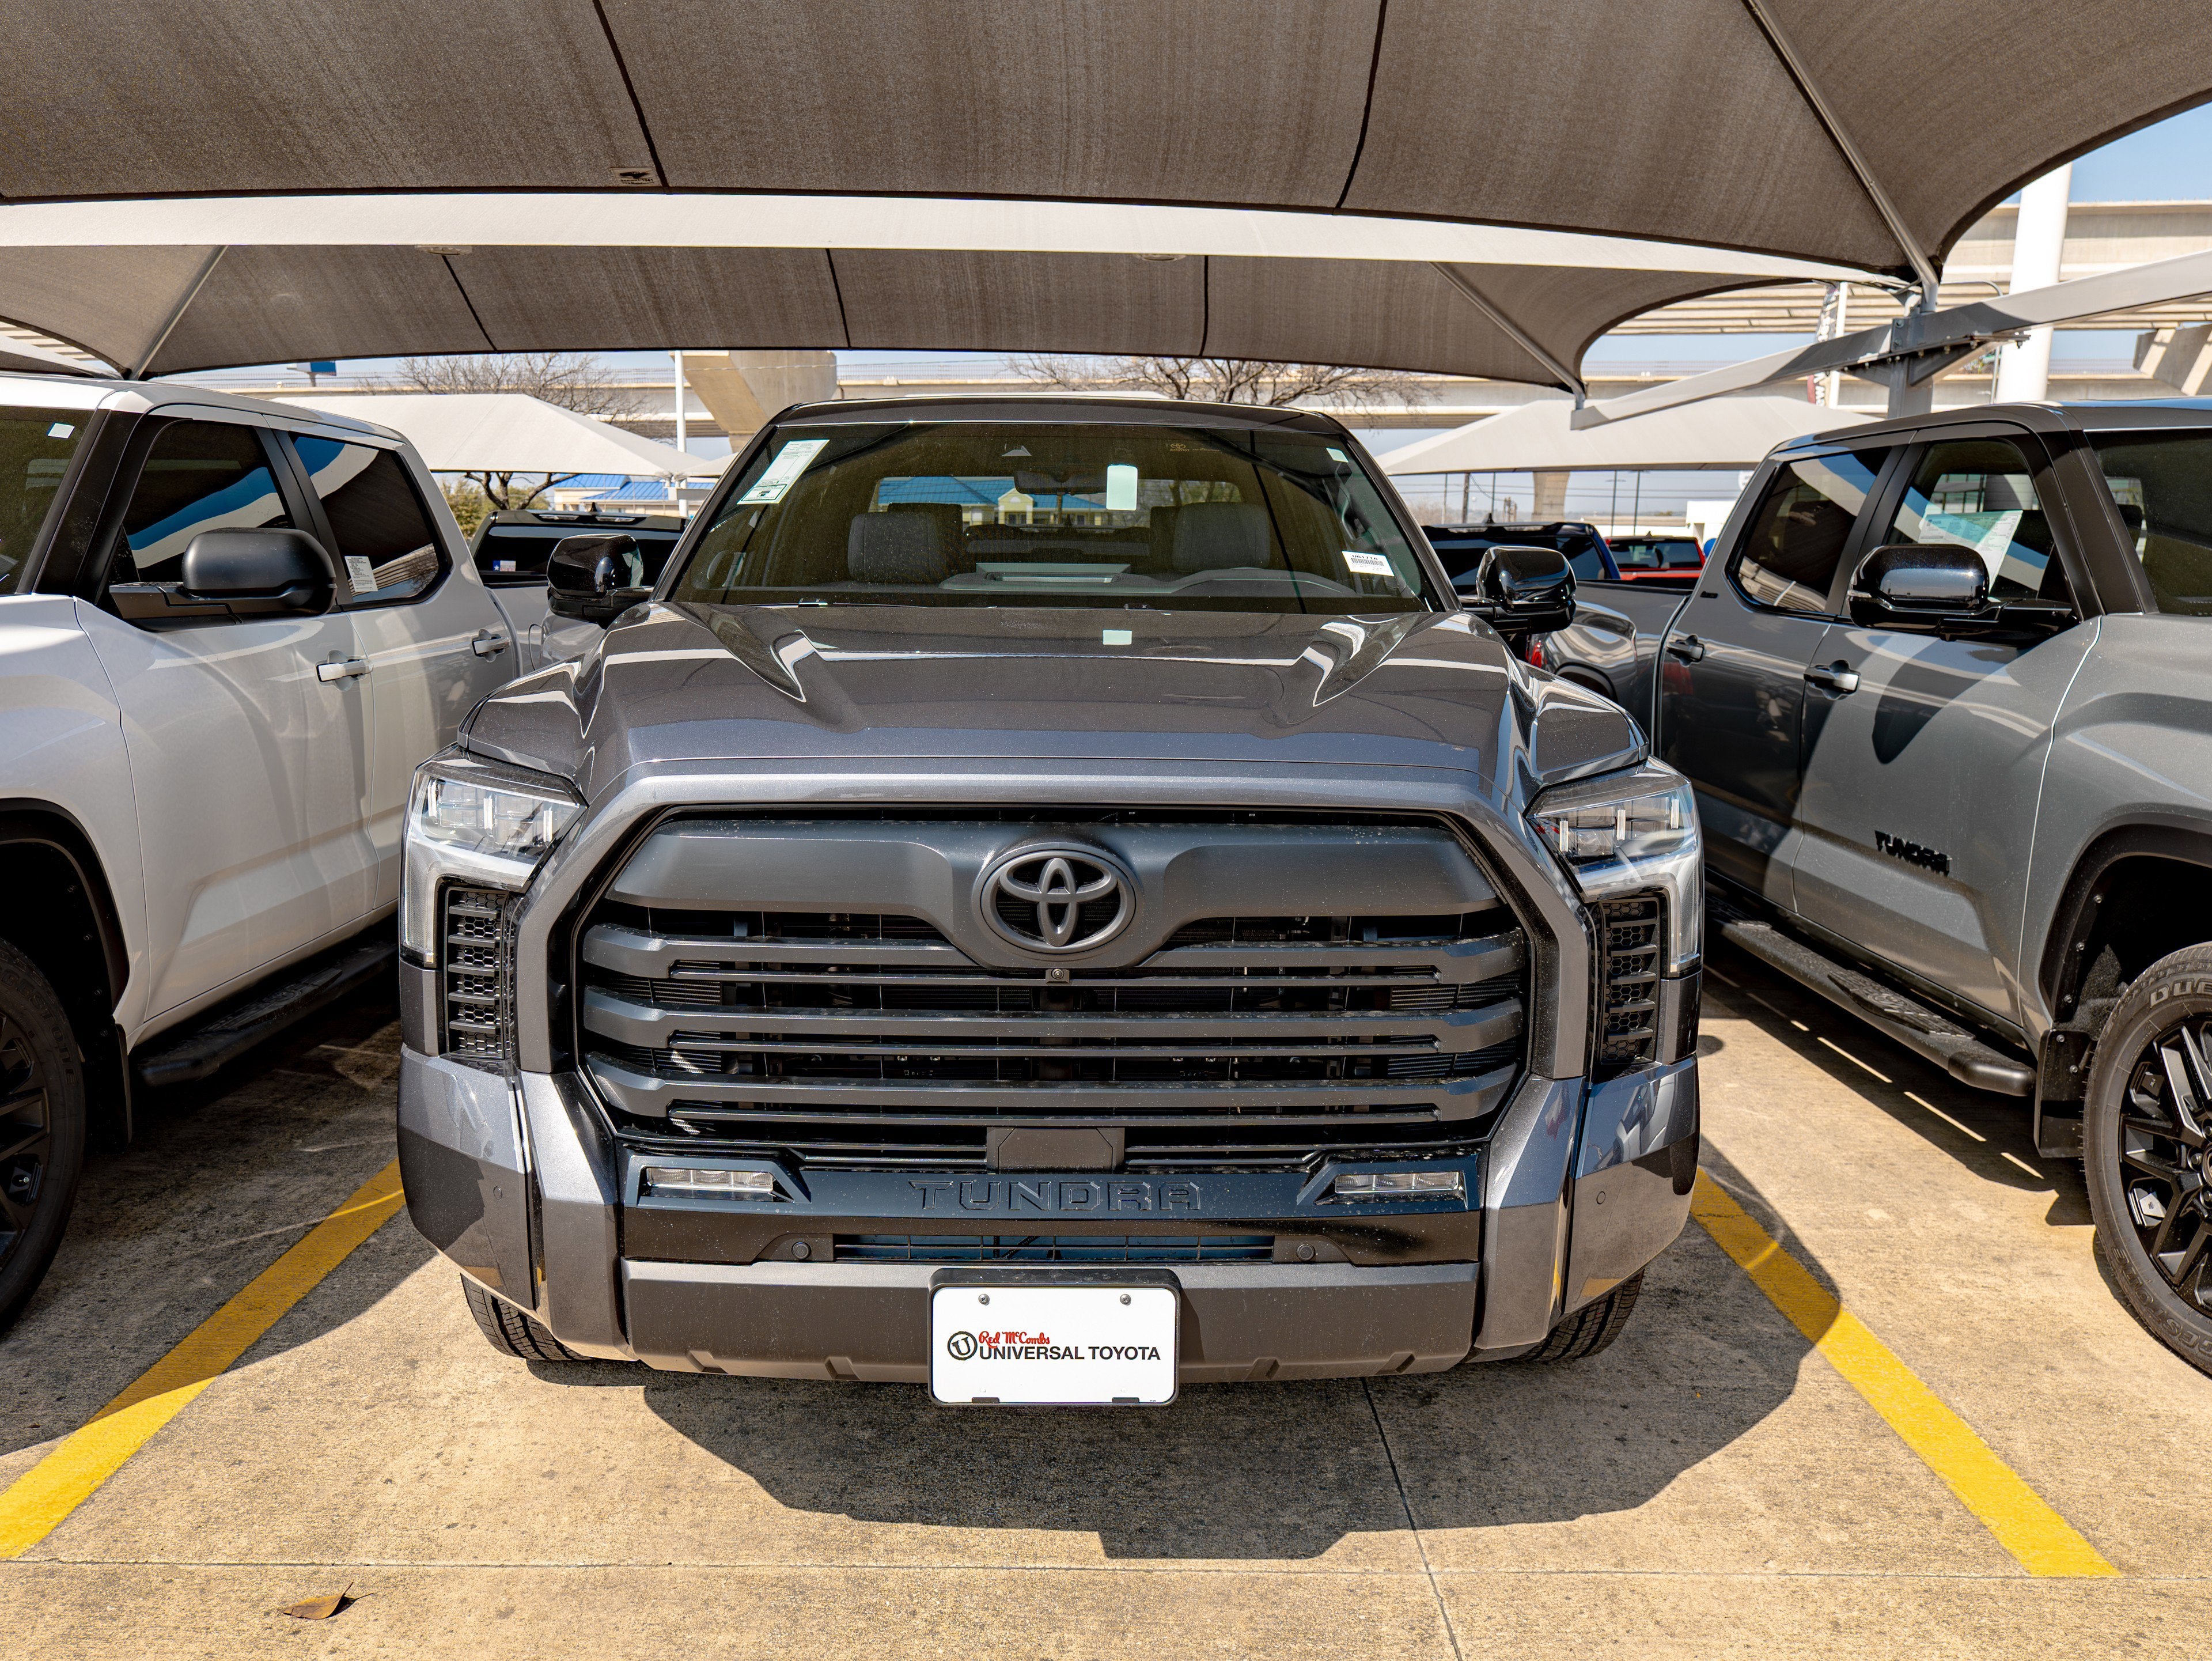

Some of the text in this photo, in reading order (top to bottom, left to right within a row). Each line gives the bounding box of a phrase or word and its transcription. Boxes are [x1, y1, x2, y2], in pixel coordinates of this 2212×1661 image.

[1874, 830, 1953, 877] TUNDRA
[908, 1180, 1201, 1211] TUNDRA
[979, 1331, 1050, 1349] Red McCombs
[979, 1346, 1161, 1360] UNIVERSAL TOYOTA
